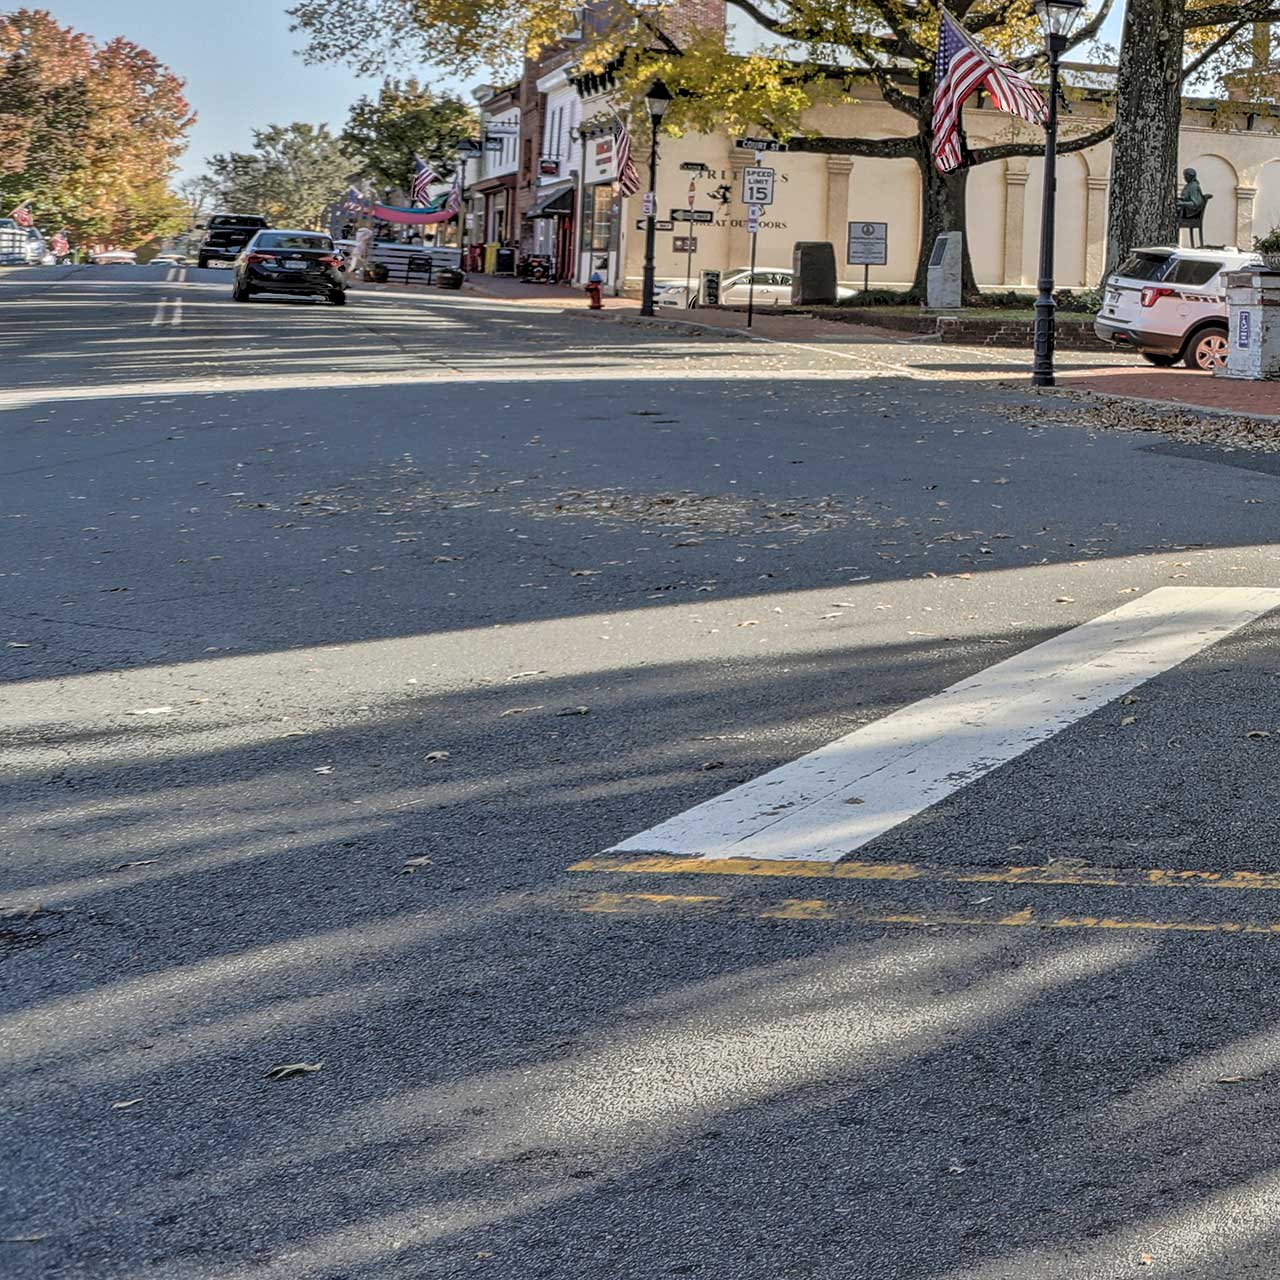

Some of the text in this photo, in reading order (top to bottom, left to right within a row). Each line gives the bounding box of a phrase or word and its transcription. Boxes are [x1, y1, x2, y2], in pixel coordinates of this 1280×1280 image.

[742, 140, 767, 150] COURT
[746, 170, 773, 178] SPEED
[748, 186, 768, 201] 15
